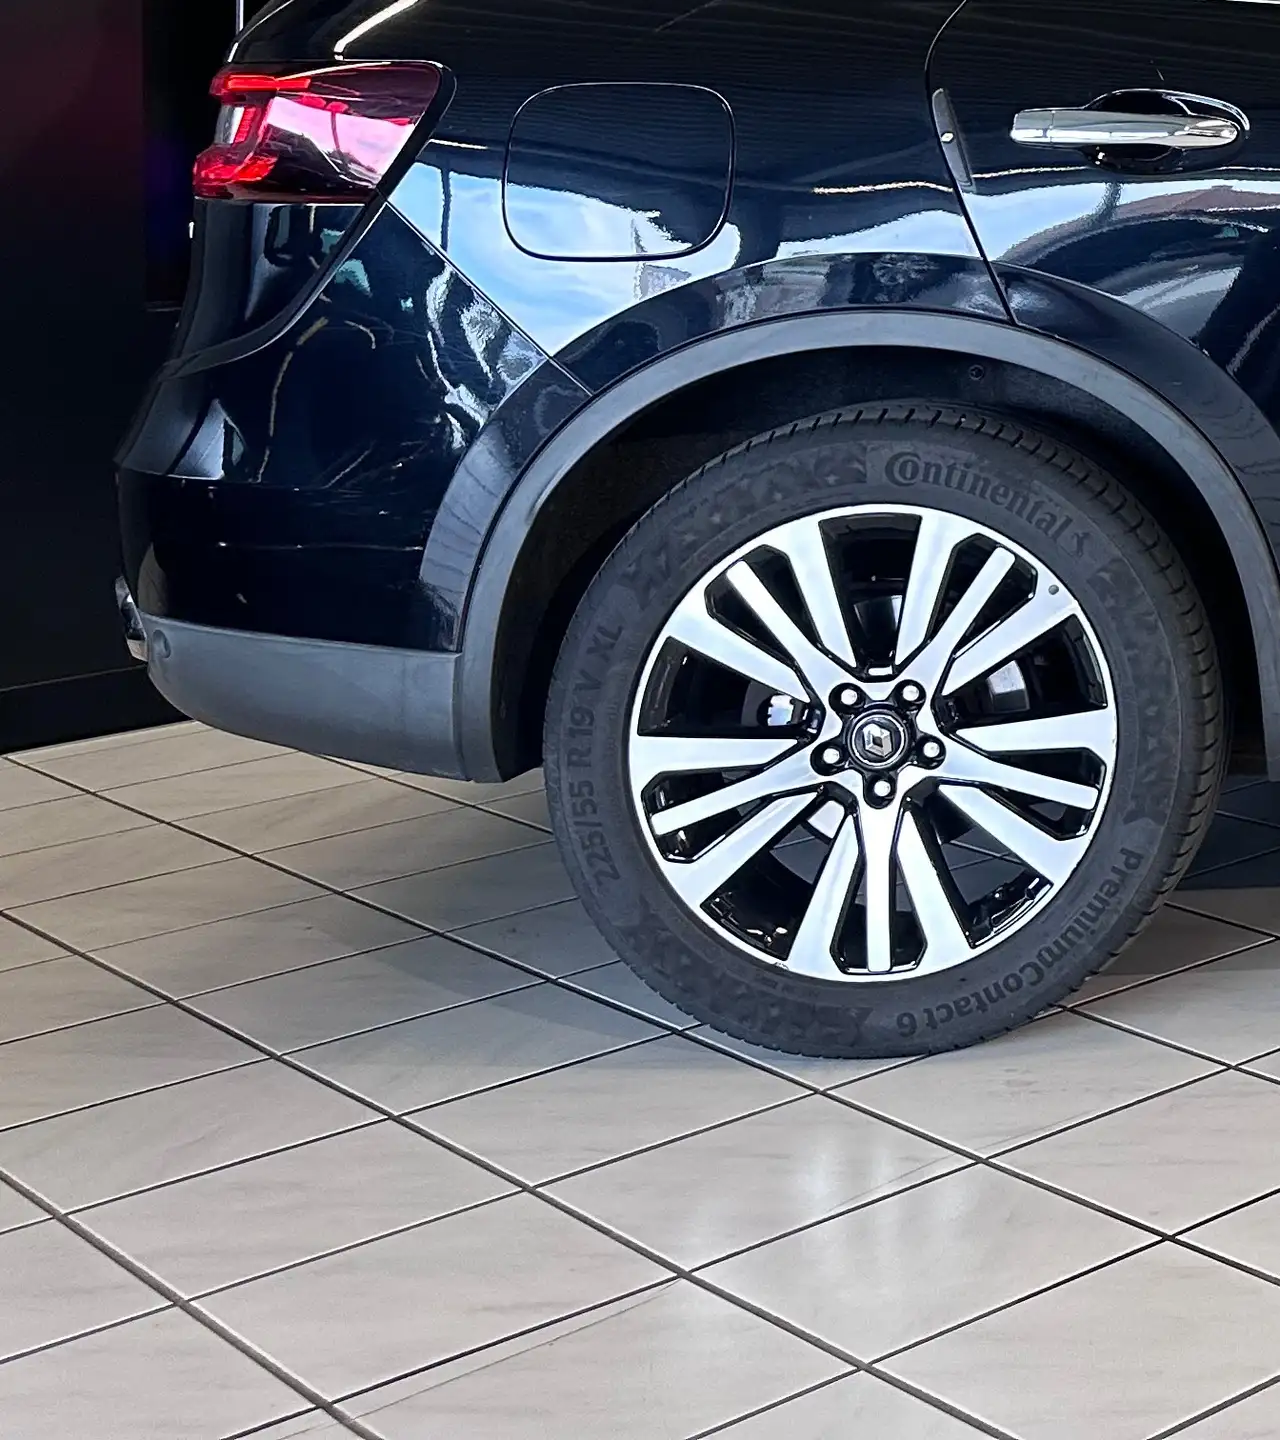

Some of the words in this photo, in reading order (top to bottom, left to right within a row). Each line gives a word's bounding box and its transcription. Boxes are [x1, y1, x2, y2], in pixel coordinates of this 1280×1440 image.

[884, 451, 1074, 541] Continental
[568, 779, 621, 886] 225/55
[924, 847, 1145, 1031] PremiumContact
[896, 1011, 918, 1038] 6
